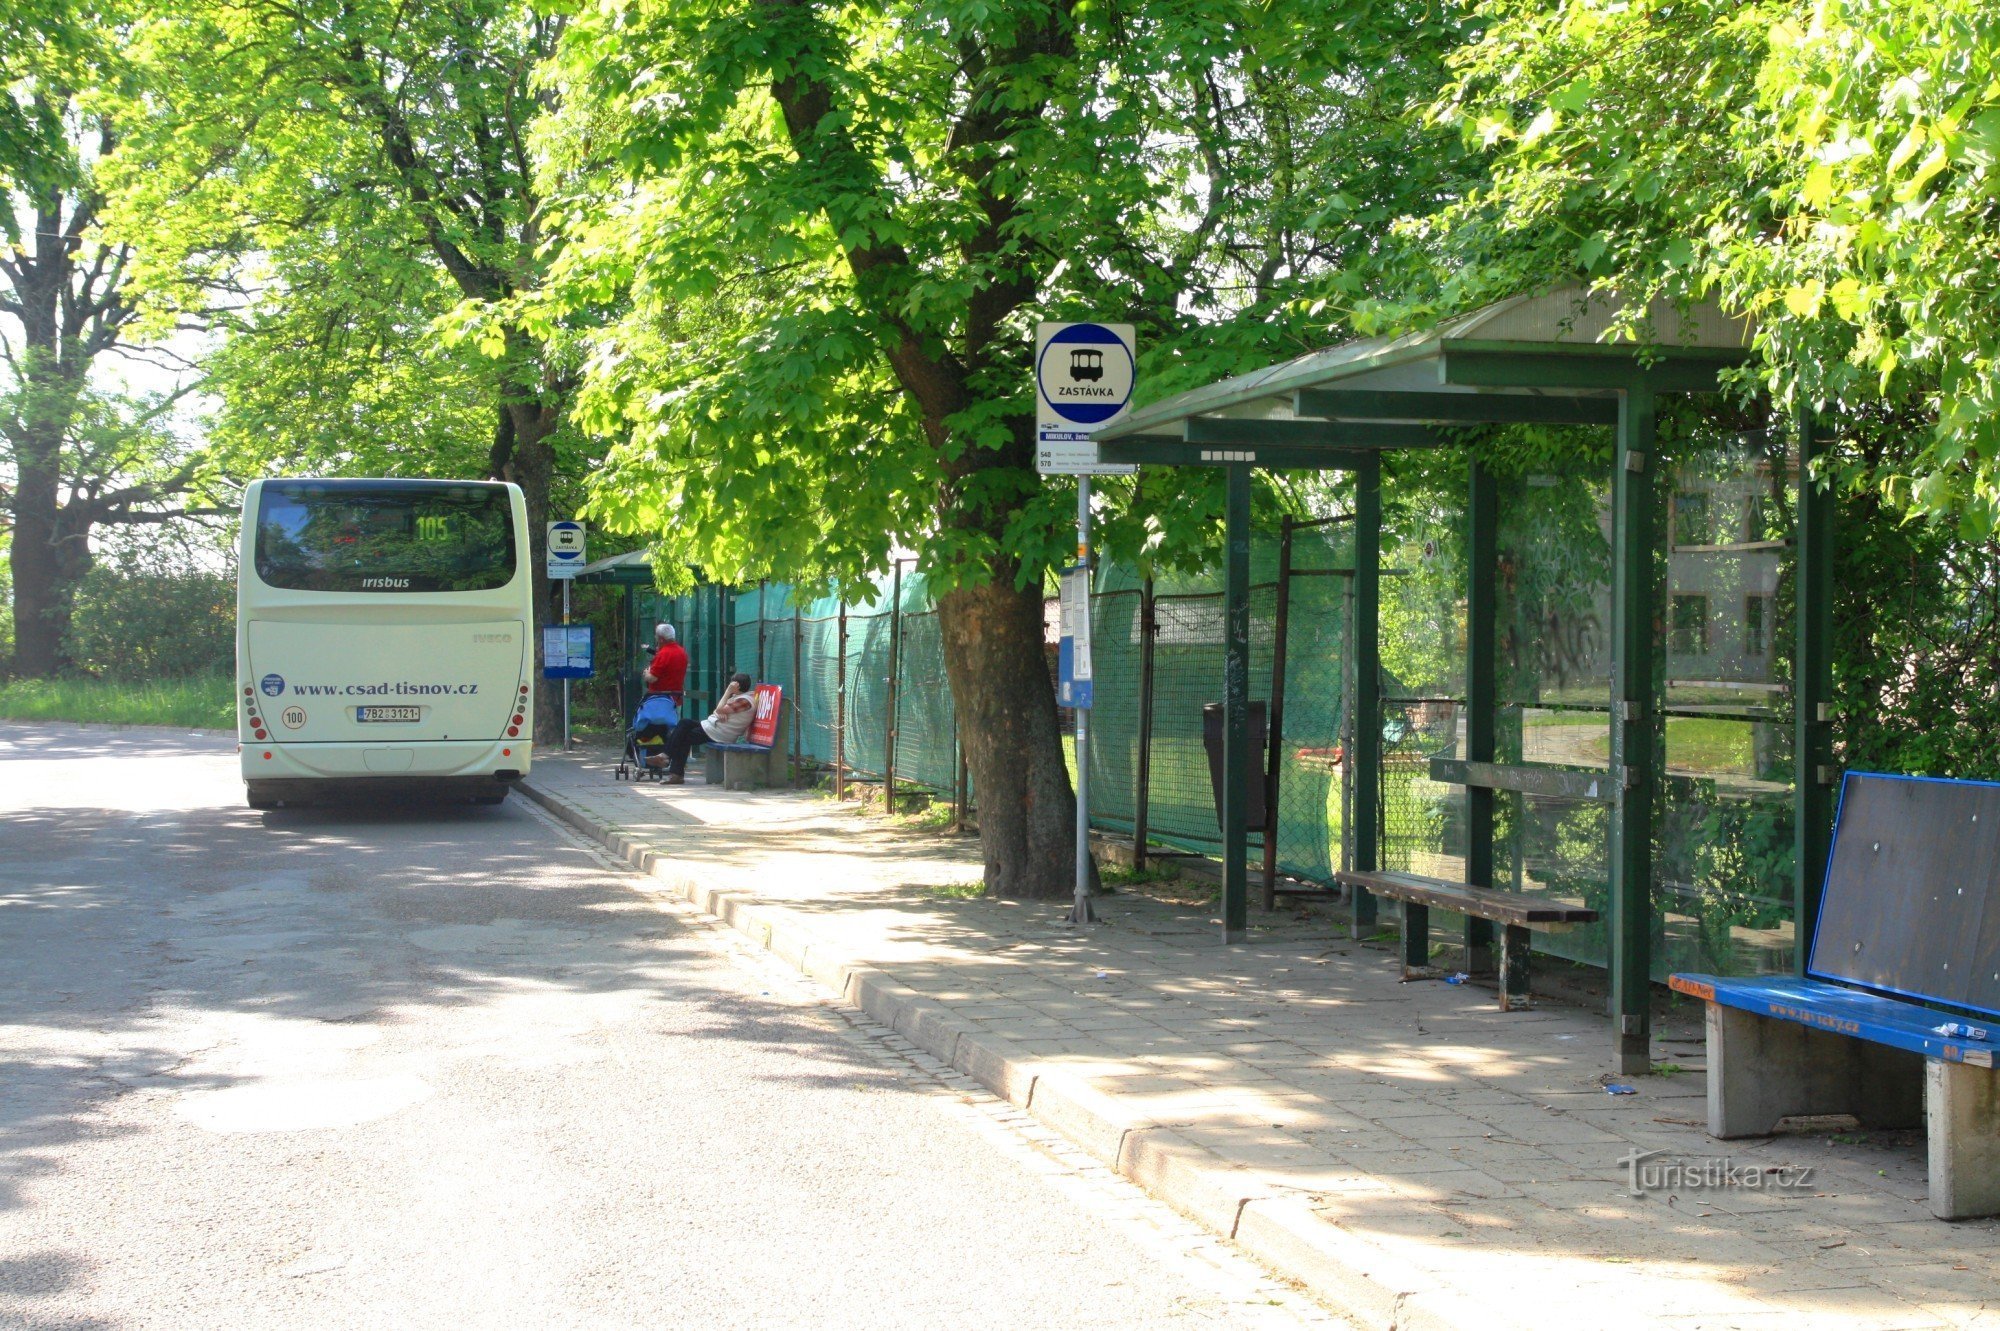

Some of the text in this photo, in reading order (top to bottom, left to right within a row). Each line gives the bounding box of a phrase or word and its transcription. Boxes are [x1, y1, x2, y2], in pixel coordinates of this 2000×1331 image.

[1059, 385, 1114, 396] ZASTÁVKA
[416, 516, 448, 540] 105
[293, 681, 478, 695] www.csad-tisnov.cz
[286, 712, 303, 723] 100
[365, 708, 415, 719] 7B2 3121
